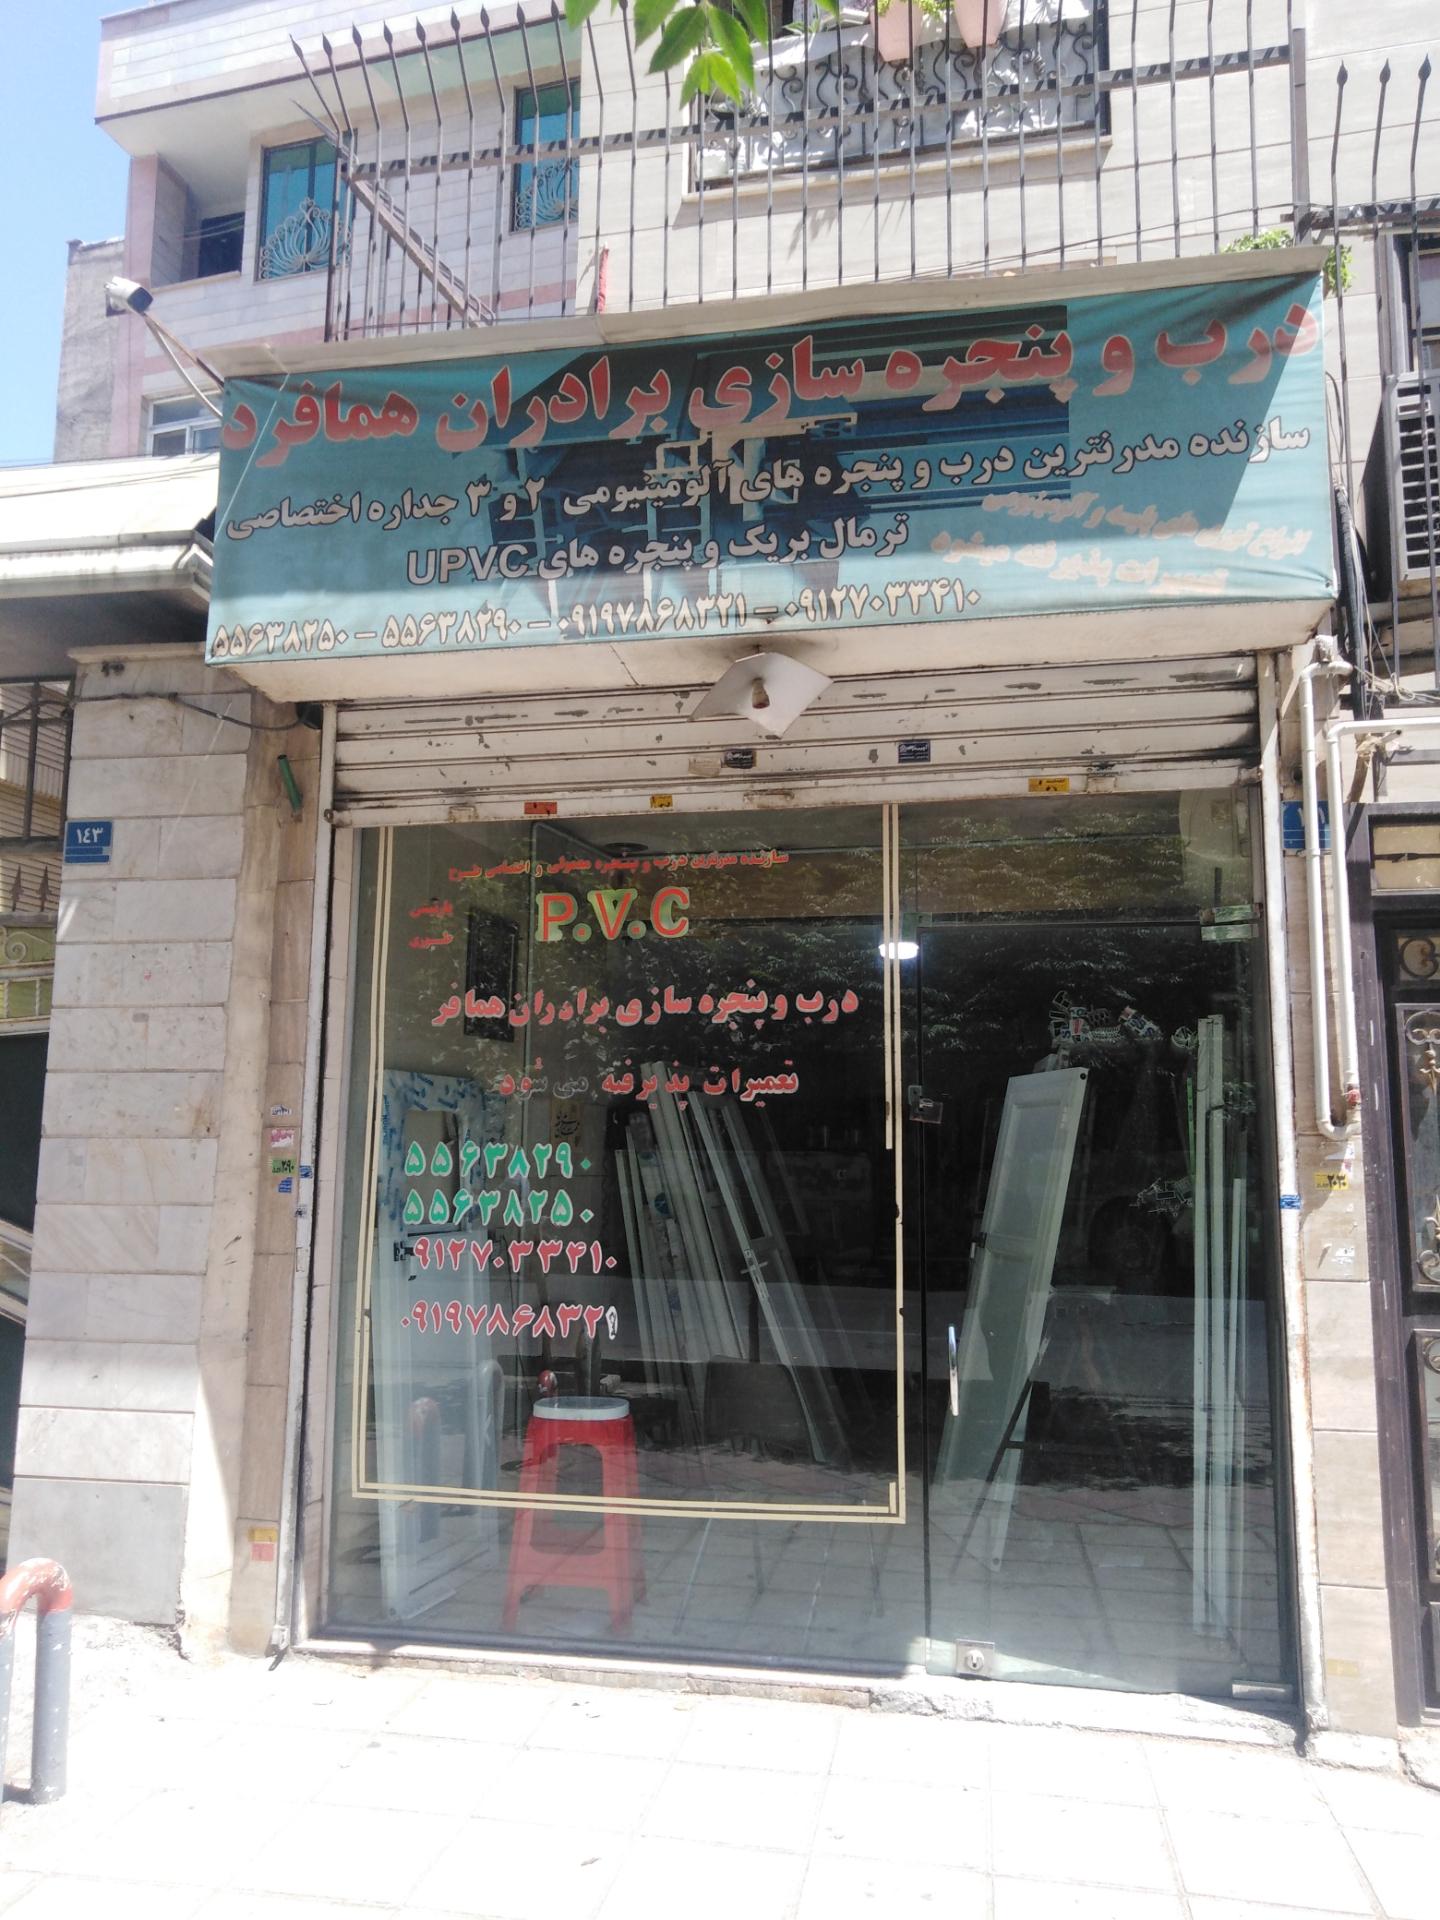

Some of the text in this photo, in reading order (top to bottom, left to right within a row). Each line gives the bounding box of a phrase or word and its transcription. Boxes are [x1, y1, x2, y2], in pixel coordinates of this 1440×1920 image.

[221, 302, 1320, 468] درب و پنجره سازی برادران همافرد
[1023, 429, 1180, 481] مدرنترین
[1188, 415, 1310, 465] سازنده
[739, 461, 805, 501] های
[815, 450, 902, 498] پنجره
[912, 456, 931, 490] و
[939, 444, 1014, 488] درب
[368, 489, 459, 532] جداره
[466, 478, 492, 518] ۳
[500, 493, 519, 520] و
[525, 477, 545, 511] ۲
[226, 494, 361, 541] اختصاصی
[406, 513, 909, 586] ترمال بریک و پنجره های UPVC
[784, 577, 982, 623] ۰۹۱۲۷۰۳۳۴۱۰
[211, 615, 349, 658] ۵۵۶۳۸۲۵۰
[382, 606, 521, 648] ۵۵۶۳۸۲۹۰
[536, 886, 690, 942] P.V.C
[432, 979, 858, 1033] درب و پنجره سازی برادران همافر
[703, 1059, 799, 1108] تعمیرات
[404, 1140, 592, 1179] ۵۵۶۳۸۲۹۰
[402, 1188, 594, 1226] ۵۵۶۳۸۲۵۰
[413, 1236, 617, 1274] ۹۱۲۷۰۳۳۴۱۰
